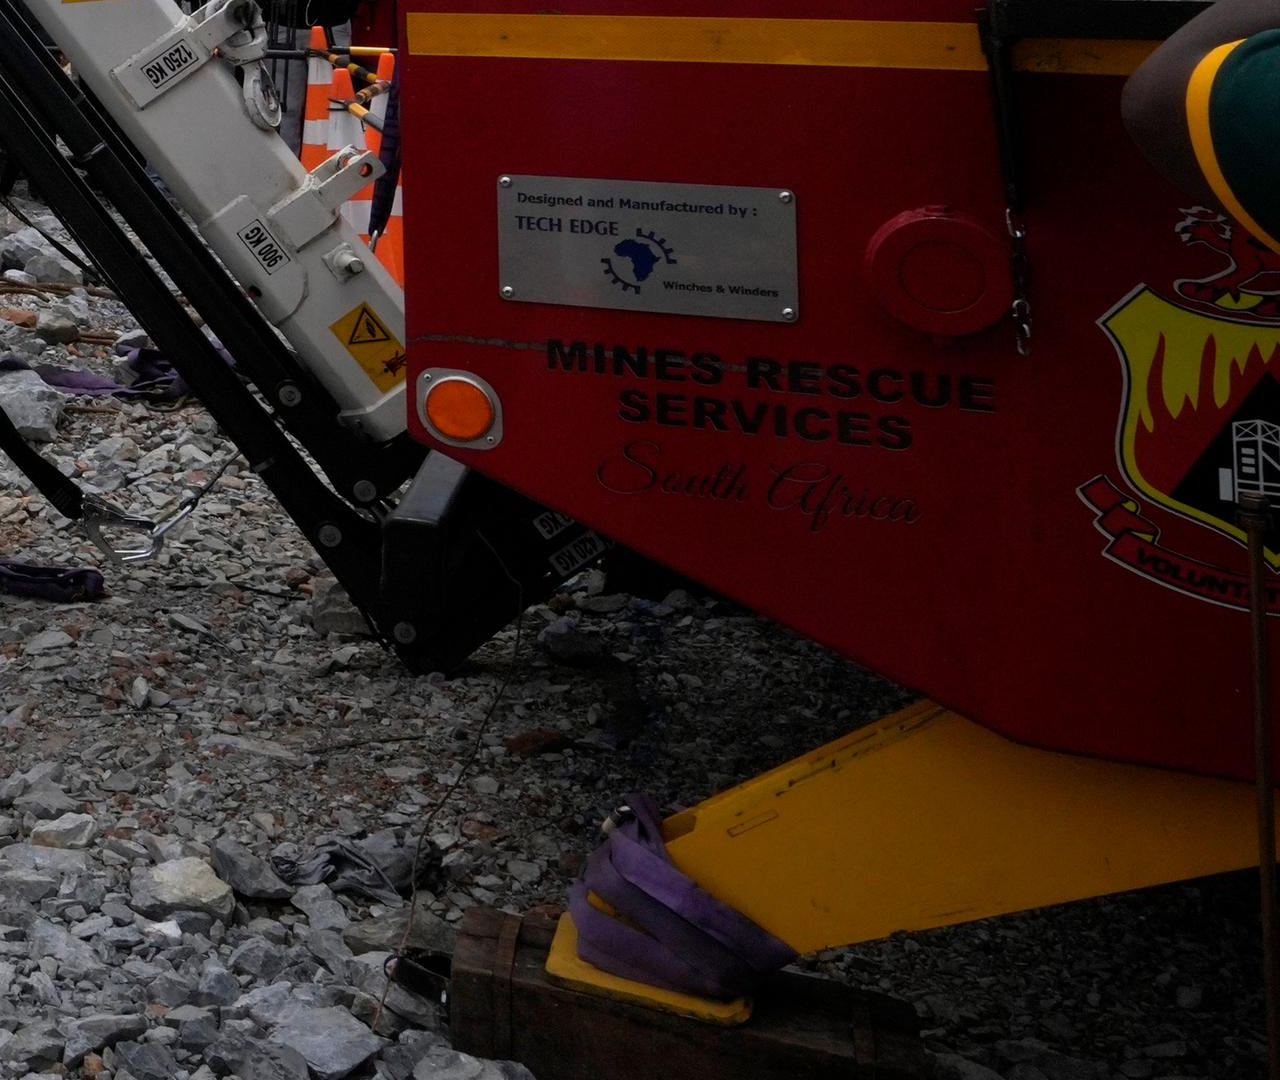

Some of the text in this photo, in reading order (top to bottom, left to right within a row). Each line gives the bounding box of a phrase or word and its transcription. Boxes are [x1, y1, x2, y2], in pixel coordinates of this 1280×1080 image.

[145, 44, 193, 84] 1250 KG
[517, 192, 583, 209] Designed
[588, 196, 614, 209] and
[619, 197, 724, 215] Manufactured
[729, 204, 748, 218] by
[515, 215, 619, 237] TECH EDGE
[244, 226, 283, 268] 900 KG
[663, 280, 779, 298] Winches & Winders
[545, 338, 998, 414] MINES RESCUE
[616, 389, 914, 451] SERVICES
[596, 440, 921, 534] South Africa
[555, 549, 579, 571] KG
